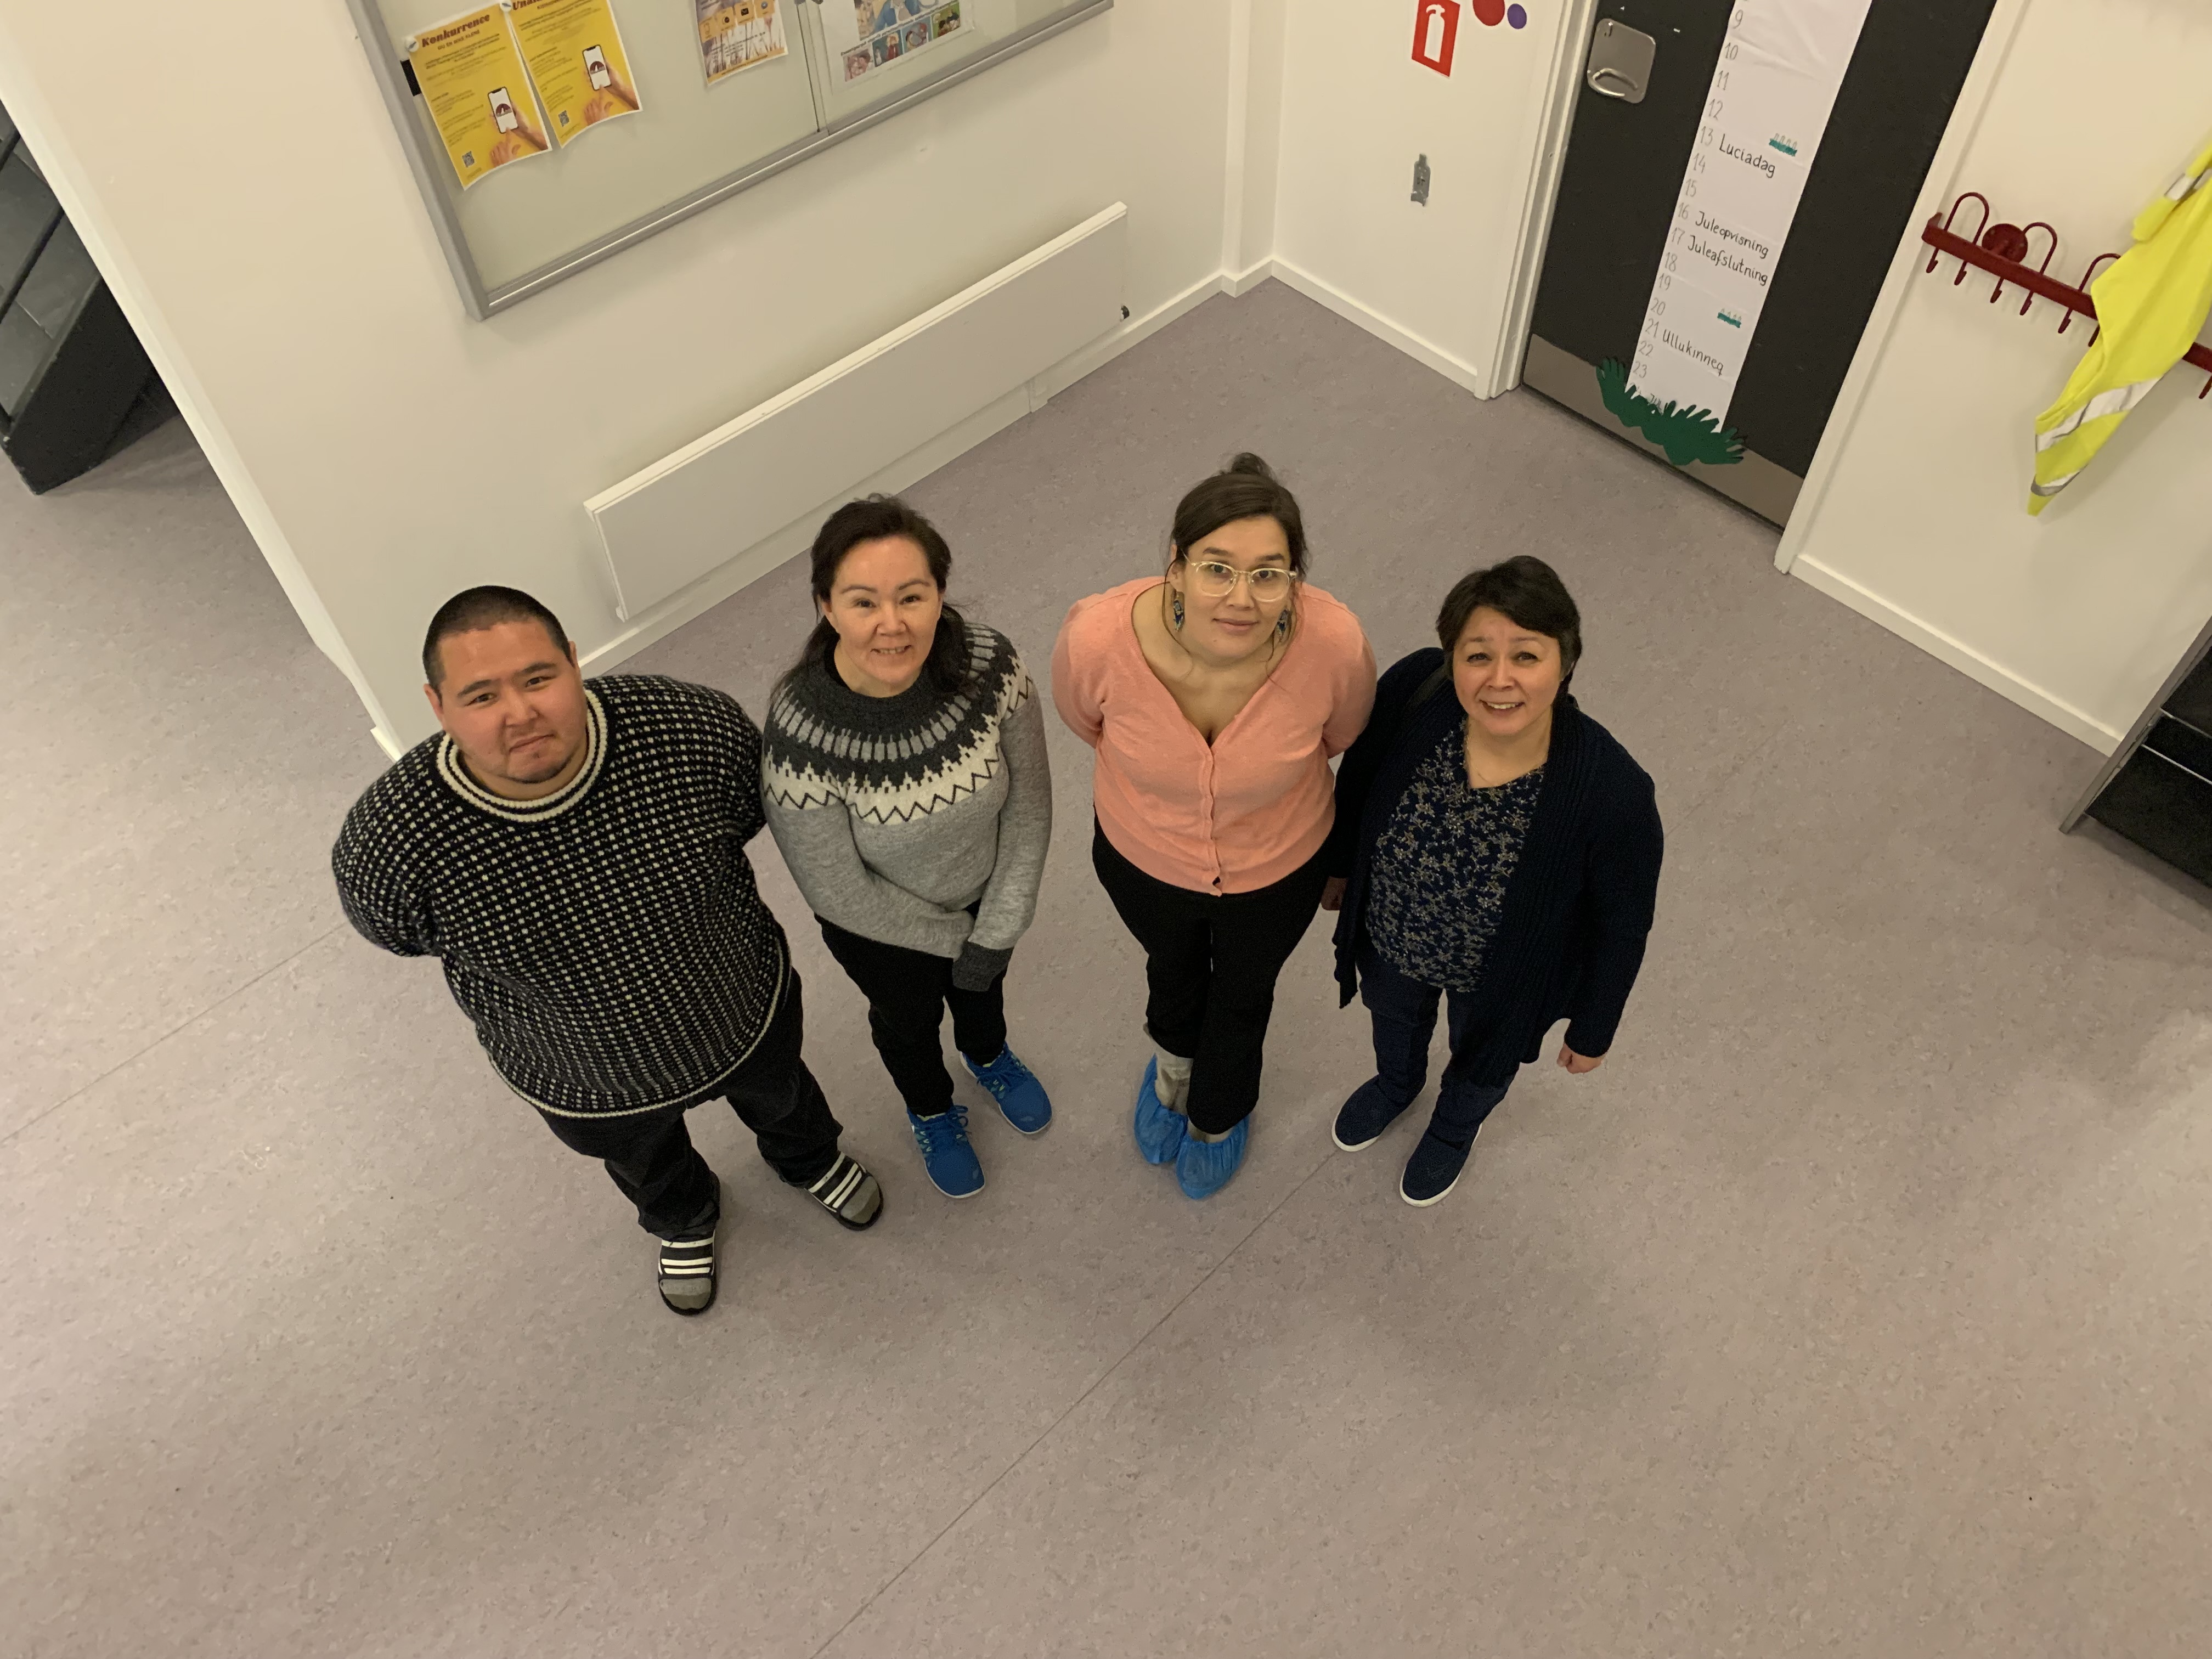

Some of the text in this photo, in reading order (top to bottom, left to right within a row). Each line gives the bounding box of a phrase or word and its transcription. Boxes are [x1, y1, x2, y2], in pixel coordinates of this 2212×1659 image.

[1733, 9, 1743, 29] 9
[422, 14, 490, 47] Konkurrence
[1724, 42, 1739, 61] 10
[1717, 70, 1729, 91] 11
[1708, 99, 1723, 120] 12
[1700, 126, 1775, 178] 13 Luciadag
[1693, 153, 1706, 174] 14
[1685, 178, 1697, 197] 15
[1678, 202, 1769, 259] 16 Juleopvisning
[1664, 252, 1677, 272] 18
[1671, 227, 1768, 286] 17 Juleafslutning
[1658, 273, 1671, 291] 19
[1651, 297, 1666, 315] 20
[1639, 340, 1654, 357] 22
[1645, 318, 1724, 376] 21 Ullukinneq
[1633, 361, 1647, 378] 23
